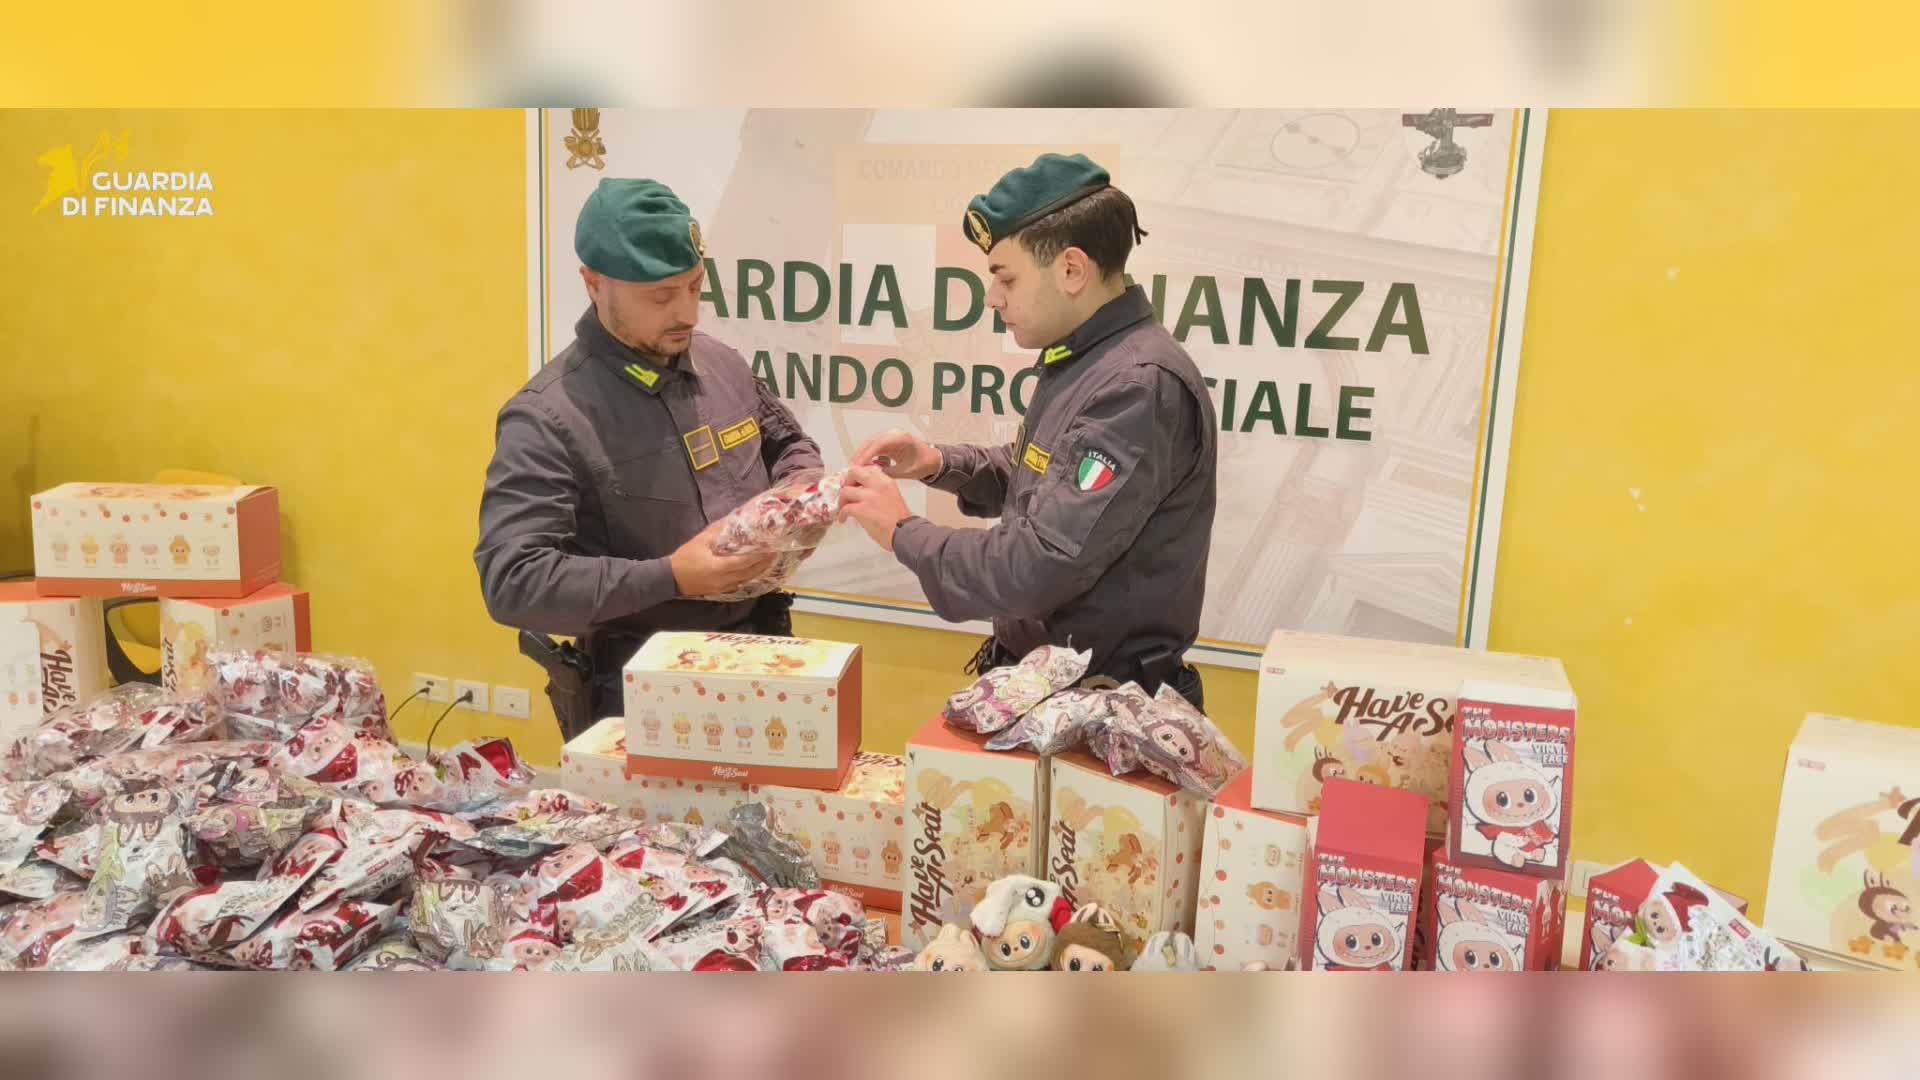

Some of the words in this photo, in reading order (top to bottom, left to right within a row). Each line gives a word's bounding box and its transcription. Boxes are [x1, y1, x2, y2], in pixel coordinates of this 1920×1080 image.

[1088, 450, 1116, 471] ITALIA
[39, 650, 78, 703] Have
[1333, 687, 1425, 725] Have
[1461, 707, 1492, 720] THE
[1359, 712, 1415, 742] A
[1463, 719, 1571, 744] MONSTERS
[1531, 741, 1568, 756] VINYL
[1542, 754, 1568, 766] FACE
[913, 802, 946, 868] Seat
[1052, 820, 1079, 889] Seat
[1317, 852, 1345, 866] THE
[911, 856, 943, 927] Have
[926, 862, 954, 908] A
[1318, 864, 1417, 894] MONSTERS
[1436, 874, 1533, 911] MONSTERS
[1590, 887, 1621, 904] THE
